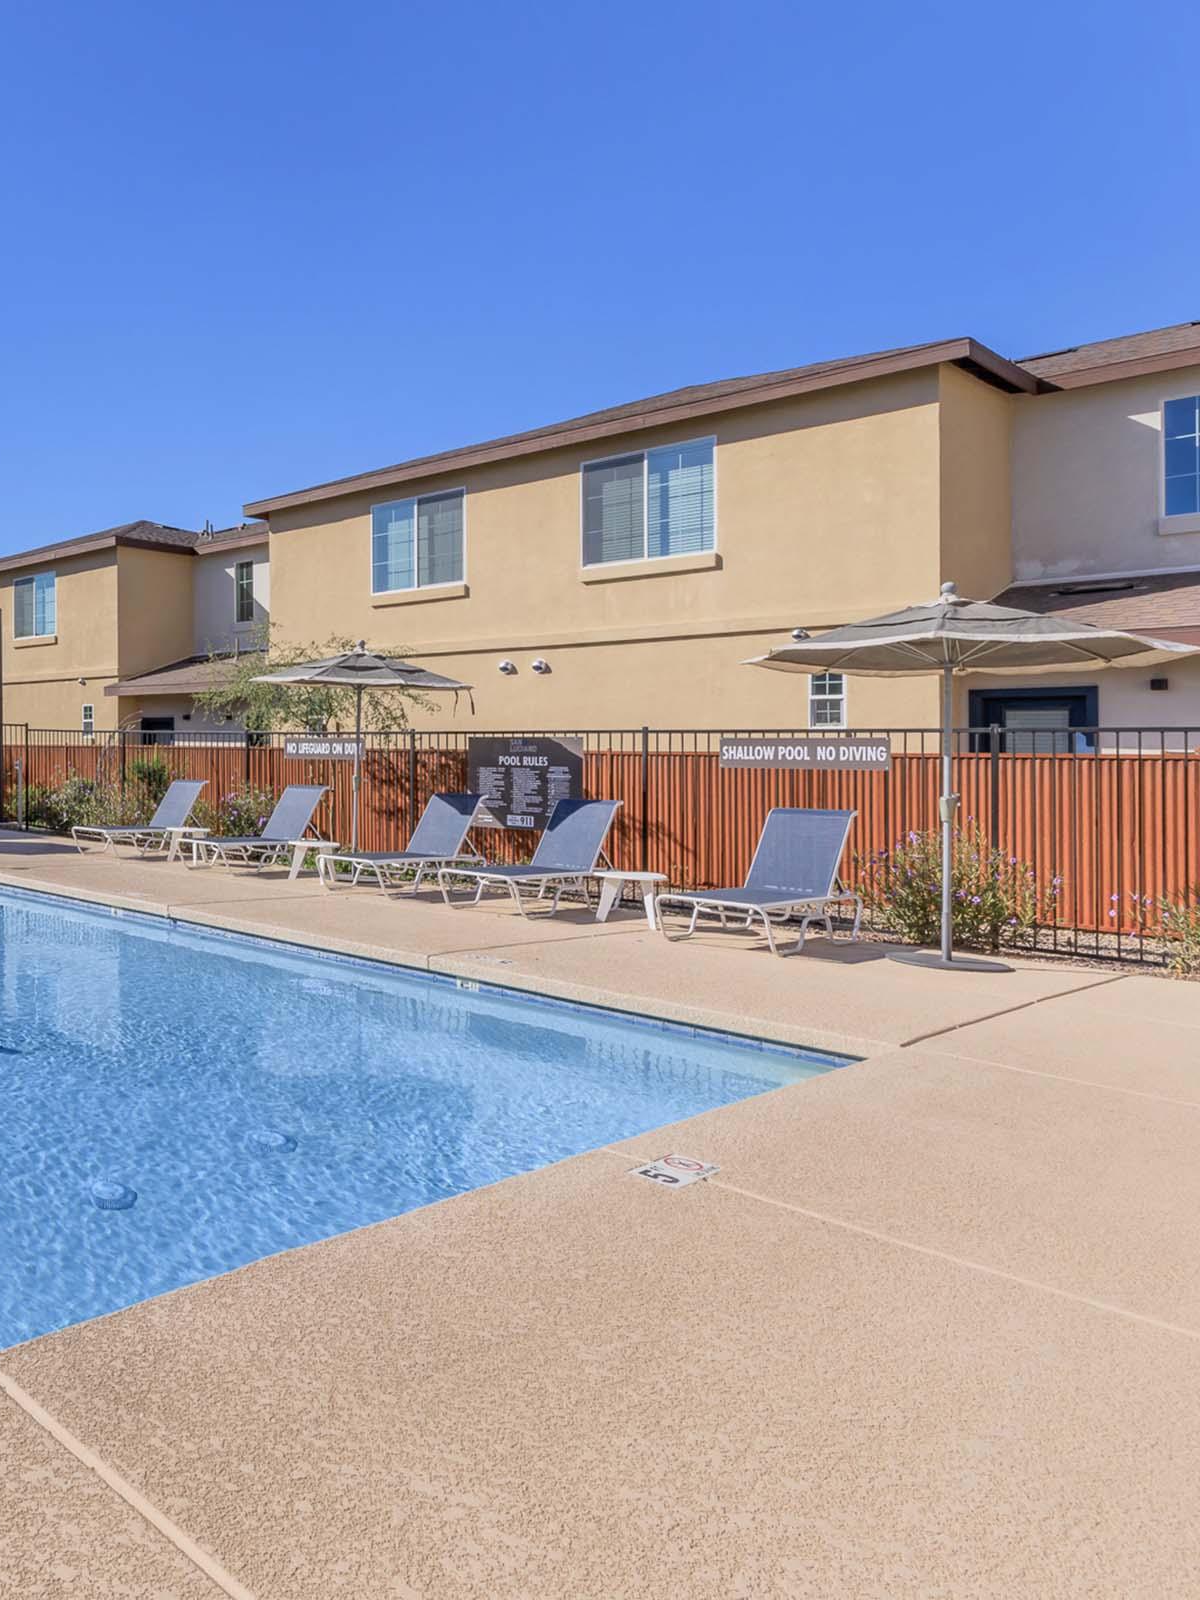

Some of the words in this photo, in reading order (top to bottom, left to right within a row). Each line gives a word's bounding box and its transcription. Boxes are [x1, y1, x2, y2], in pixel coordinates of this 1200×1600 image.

[286, 742, 297, 754] NO
[298, 742, 330, 754] LIFEGUARD
[332, 742, 343, 754] ON
[722, 745, 775, 760] SHALLOW
[778, 745, 810, 761] POOL
[816, 745, 836, 761] NO
[839, 745, 888, 762] DIVING
[498, 755, 521, 766] POOL
[522, 756, 548, 766] RULES
[520, 816, 533, 826] 911
[638, 1169, 680, 1184] 5
